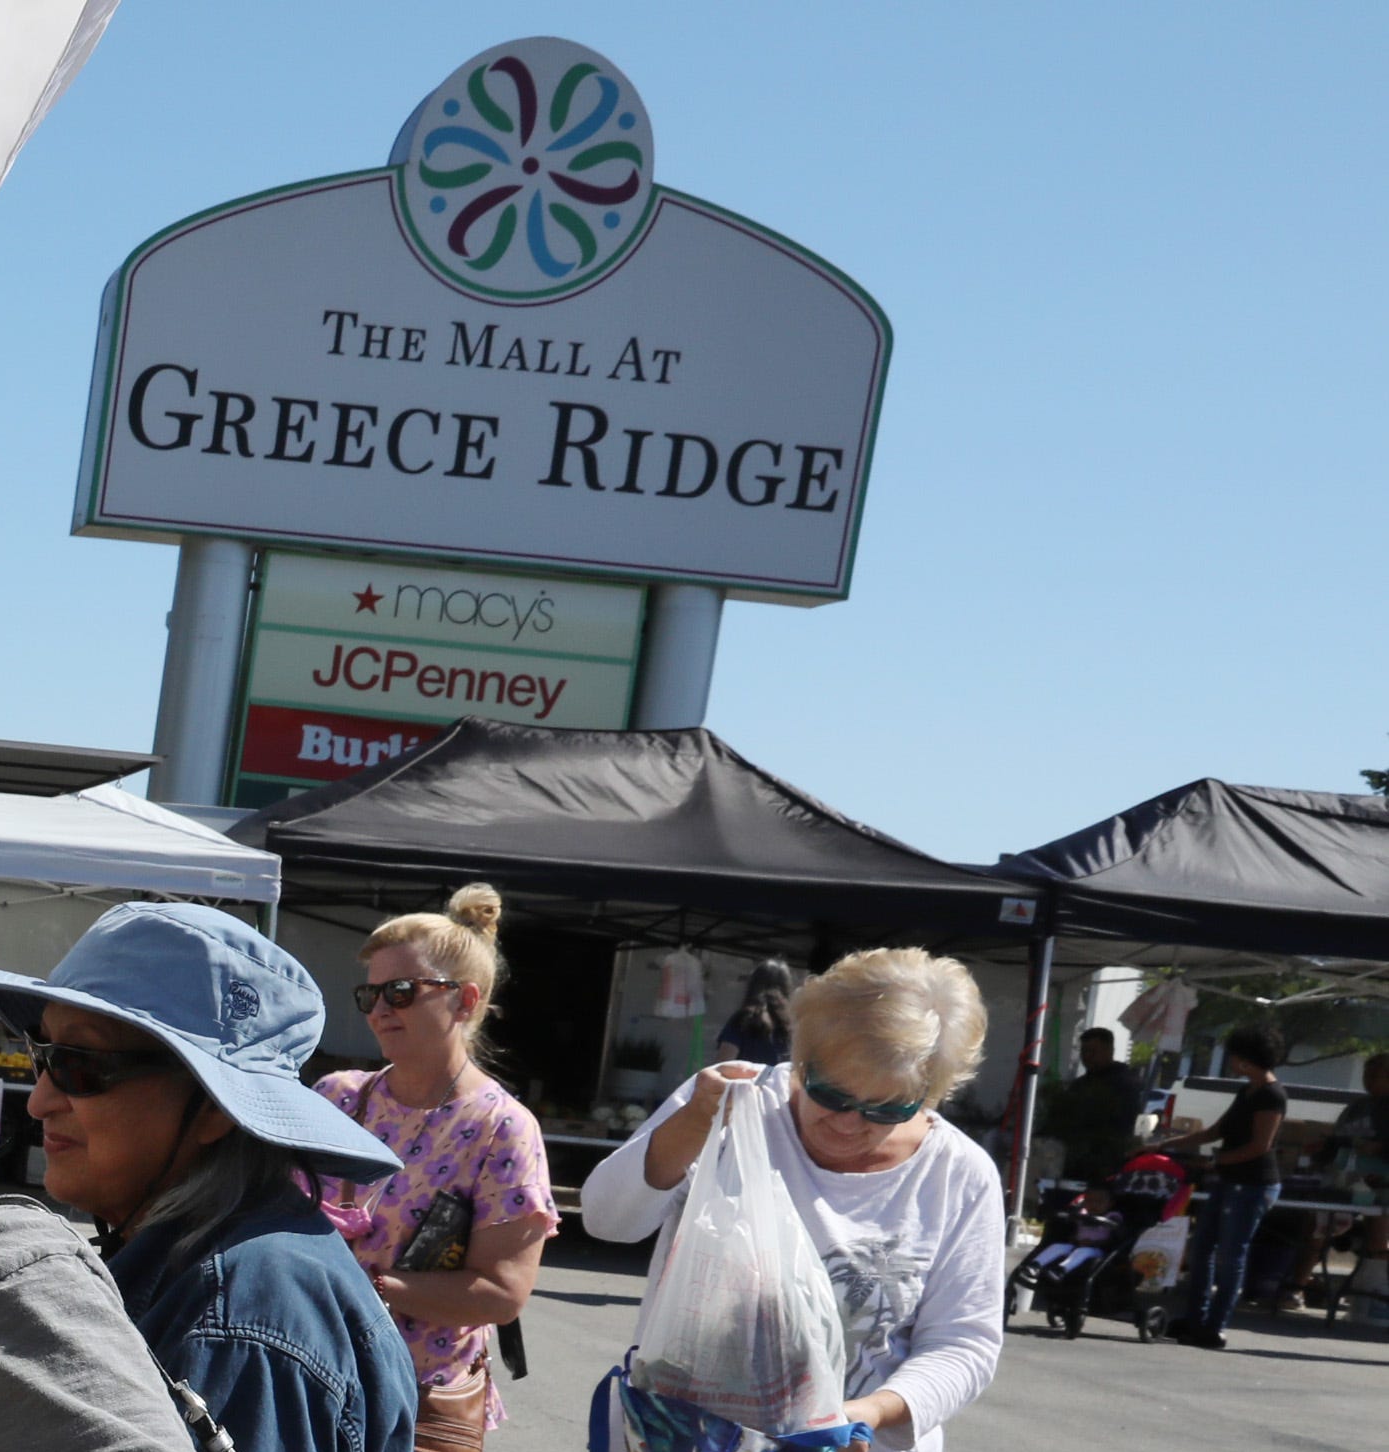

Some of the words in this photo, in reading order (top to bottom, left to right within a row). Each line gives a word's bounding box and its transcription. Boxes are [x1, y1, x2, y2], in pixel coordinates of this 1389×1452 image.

[322, 309, 427, 363] THE
[444, 320, 592, 378] MALL
[606, 336, 682, 385] AT
[127, 362, 501, 481] GREECE
[537, 400, 845, 514] RIDGE
[312, 643, 568, 720] JCPenney
